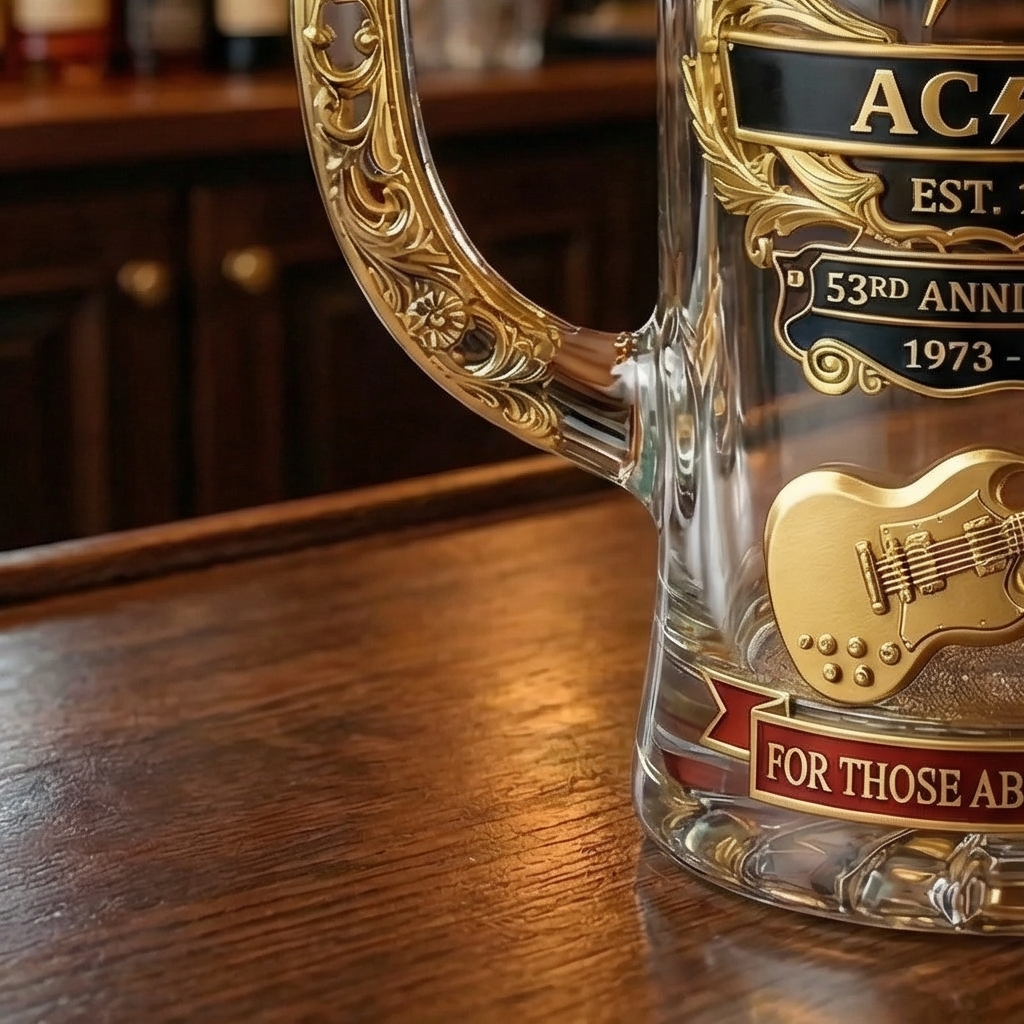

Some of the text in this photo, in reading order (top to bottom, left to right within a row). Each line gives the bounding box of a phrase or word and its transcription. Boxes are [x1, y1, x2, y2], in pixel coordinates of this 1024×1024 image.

[910, 178, 1002, 216] EST.
[825, 272, 910, 306] 53RD
[903, 339, 994, 373] 1973
[767, 742, 830, 792] FOR
[839, 756, 963, 808] THOSE
